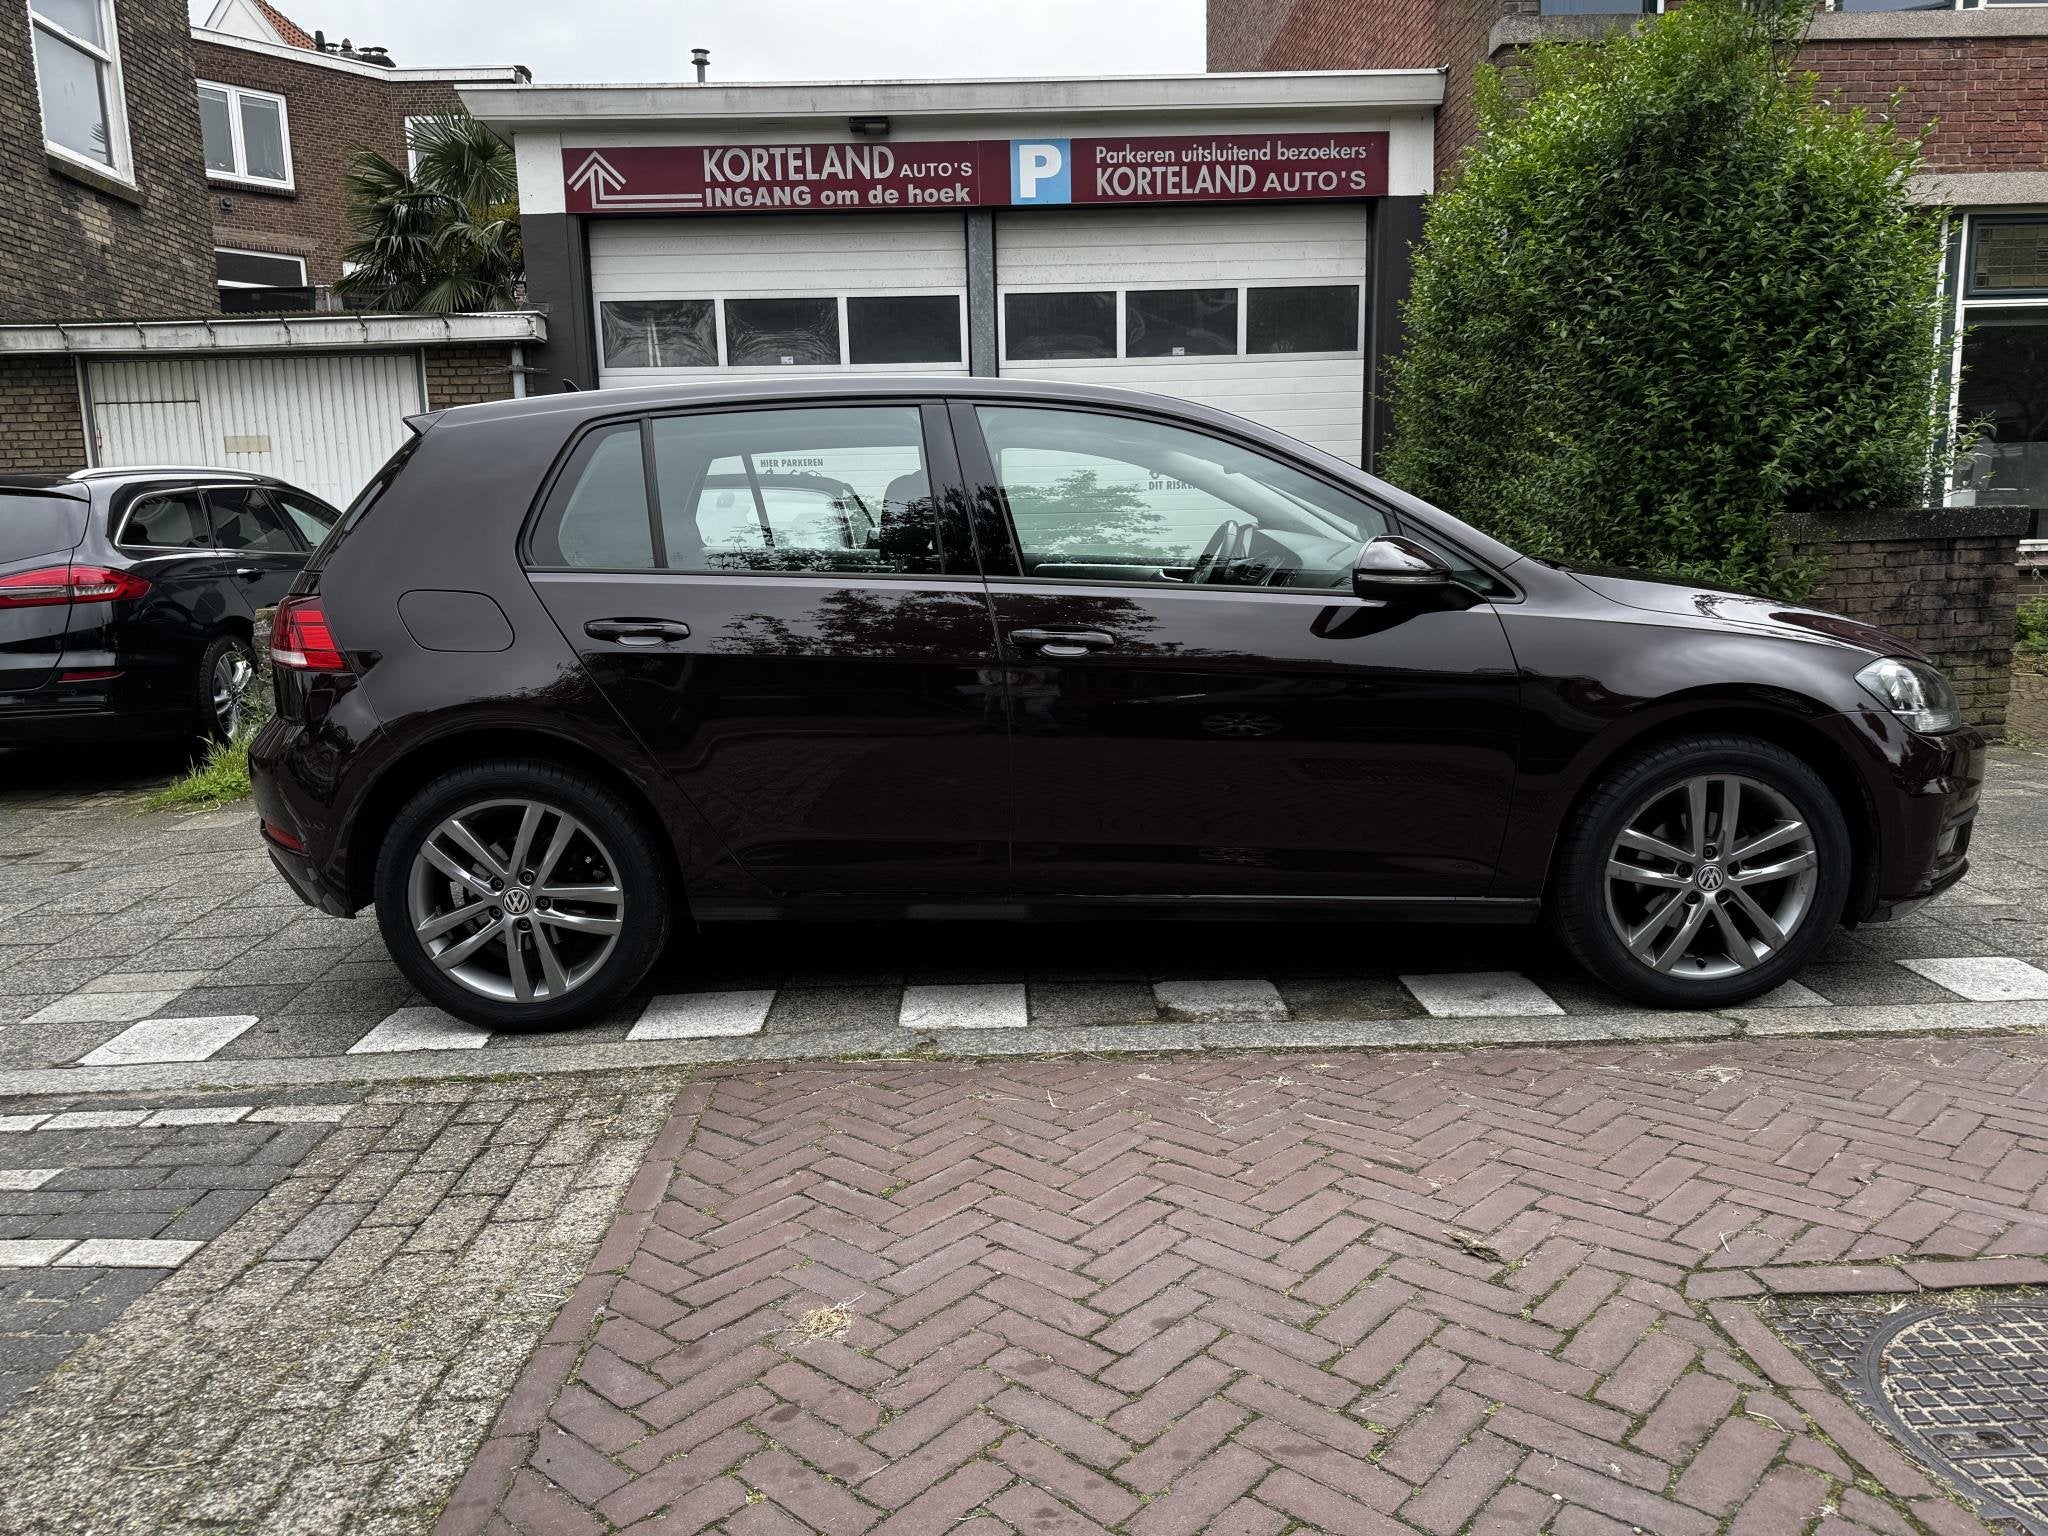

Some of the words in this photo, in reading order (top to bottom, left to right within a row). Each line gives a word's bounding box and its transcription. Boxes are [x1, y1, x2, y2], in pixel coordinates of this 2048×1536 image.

[1096, 145, 1174, 164] Parkeren
[1181, 141, 1270, 162] uitsluitend
[1277, 140, 1367, 160] bezoekers
[703, 146, 895, 183] KORTELAND
[900, 163, 973, 178] AUTO'S
[1018, 144, 1062, 198] P
[1096, 164, 1256, 196] KORTELAND
[1263, 171, 1367, 192] AUTO'S
[705, 186, 811, 207] INGANG
[820, 189, 859, 206] om
[867, 185, 899, 205] de
[907, 183, 970, 203] hoek
[760, 459, 779, 468] HIER
[781, 458, 824, 468] PARKEREN
[1148, 480, 1164, 491] DIT
